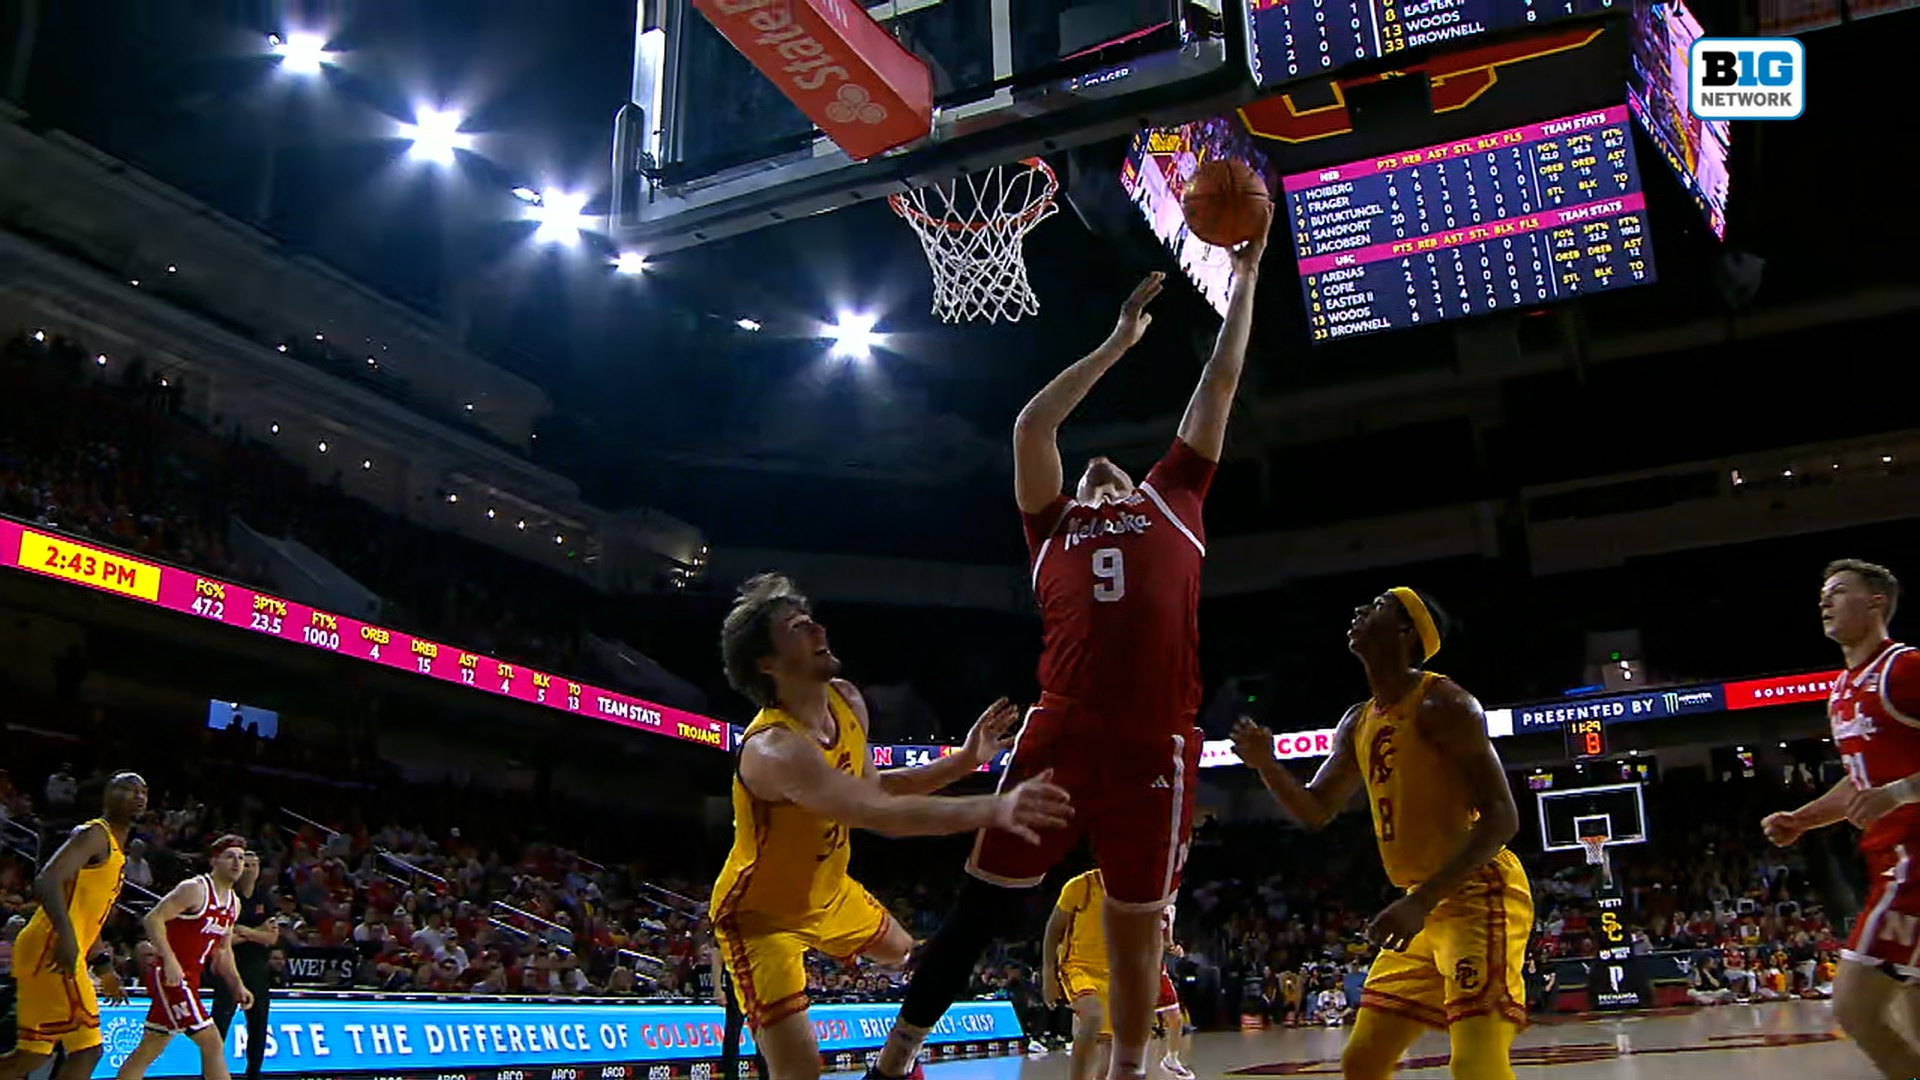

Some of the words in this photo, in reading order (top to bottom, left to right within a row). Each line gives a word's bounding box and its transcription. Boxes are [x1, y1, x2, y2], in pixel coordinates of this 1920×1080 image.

[1383, 25, 1402, 38] 13
[1406, 11, 1460, 31] WOODS
[1386, 9, 1395, 21] 8
[1386, 38, 1404, 52] 33
[1409, 22, 1484, 46] BROWNELL
[1527, 11, 1536, 22] 8
[1541, 121, 1572, 135] TEAM
[1574, 114, 1605, 129] STATS
[1377, 159, 1397, 169] PTS
[1402, 154, 1421, 164] REB
[1428, 148, 1447, 159] AST
[1454, 144, 1472, 153] STL
[1478, 137, 1498, 148] BLK
[1294, 194, 1299, 202] 1
[1306, 183, 1353, 199] HOIBERG
[1386, 174, 1392, 184] 7
[1412, 169, 1419, 178] 4
[1437, 164, 1444, 173] 2
[1464, 159, 1469, 167] 1
[1488, 153, 1495, 163] 0
[1296, 206, 1302, 215] 5
[1308, 197, 1350, 212] FRAGER
[1389, 187, 1396, 196] 8
[1414, 182, 1421, 191] 6
[1440, 177, 1446, 185] 1
[1466, 171, 1472, 180] 1
[1490, 166, 1497, 176] 0
[1298, 219, 1305, 229] 9
[1392, 201, 1399, 210] 6
[1417, 195, 1424, 205] 5
[1442, 191, 1449, 200] 3
[1468, 185, 1475, 195] 3
[1494, 181, 1499, 189] 1
[1391, 213, 1404, 225] 20
[1419, 209, 1426, 219] 3
[1445, 204, 1452, 213] 0
[1470, 199, 1478, 209] 2
[1496, 194, 1502, 203] 0
[1558, 208, 1588, 221] TEAM
[1590, 201, 1622, 215] STATS
[1316, 234, 1370, 253] JACOBSEN
[1397, 228, 1404, 237] 0
[1422, 223, 1428, 232] 0
[1447, 218, 1454, 227] 0
[1473, 213, 1480, 222] 0
[1498, 207, 1505, 217] 0
[1393, 243, 1412, 252] PTS
[1418, 238, 1437, 249] REB
[1444, 233, 1463, 243] AST
[1470, 229, 1488, 238] STL
[1494, 224, 1514, 234] BLK
[1309, 277, 1315, 285] 0
[1322, 267, 1364, 283] ARENAS
[1402, 259, 1410, 267] 4
[1428, 253, 1434, 263] 0
[1453, 249, 1460, 258] 2
[1479, 244, 1485, 252] 1
[1504, 239, 1511, 249] 0
[1311, 290, 1318, 298] 6
[1324, 282, 1355, 296] COFIE
[1404, 272, 1412, 281] 2
[1431, 267, 1436, 275] 1
[1456, 262, 1462, 271] 0
[1481, 257, 1488, 267] 0
[1506, 252, 1513, 261] 0
[1312, 316, 1325, 325] 13
[1328, 307, 1370, 323] WOODS
[1409, 299, 1416, 308] 9
[1434, 293, 1441, 303] 3
[1460, 289, 1468, 298] 4
[1486, 284, 1493, 294] 2
[1511, 279, 1518, 289] 0
[1314, 303, 1320, 311] 8
[1326, 293, 1366, 309] EASTER
[1408, 285, 1414, 294] 6
[1432, 280, 1439, 289] 3
[1457, 275, 1464, 285] 2
[1484, 271, 1490, 280] 0
[1508, 266, 1515, 275] 0
[1315, 329, 1328, 339] 33
[1331, 318, 1390, 336] BROWNELL
[1412, 312, 1419, 321] 8
[1438, 308, 1443, 316] 1
[1462, 303, 1470, 313] 0
[1488, 298, 1496, 308] 0
[1514, 293, 1520, 303] 3
[44, 546, 97, 577] 2:43
[103, 561, 136, 588] PM
[1092, 548, 1125, 602] 9
[192, 597, 223, 619] 47.2
[251, 612, 282, 633] 23.5
[304, 627, 338, 649] 100.0
[370, 645, 379, 659] 4
[418, 657, 430, 673] 15
[462, 669, 474, 684] 12
[501, 679, 509, 693] 4
[538, 689, 544, 702] 5
[568, 696, 579, 709] 13
[196, 579, 225, 599] FG%
[254, 595, 286, 615] 3PT%
[312, 612, 336, 630] FT%
[361, 627, 389, 643] OREB
[412, 640, 437, 657] DREB
[459, 653, 478, 667] AST
[498, 664, 514, 678] STL
[534, 673, 550, 687] BLK
[568, 683, 580, 695] TO
[598, 697, 628, 717] TEAM
[630, 706, 660, 726] STATS
[1522, 702, 1624, 726] PRESENTED
[1632, 699, 1653, 714] BY
[678, 723, 720, 744] TROJANS
[1277, 733, 1336, 754] COR
[873, 747, 892, 766] N
[905, 750, 930, 767] 54
[1598, 898, 1622, 908] YETI
[963, 1013, 995, 1034] CRISP
[234, 1023, 330, 1058] ASTE
[344, 1024, 413, 1054] THE
[424, 1024, 591, 1053] DIFFERENCE
[600, 1023, 628, 1050] OF
[641, 1023, 725, 1049] GOLDEN
[601, 1067, 625, 1078] ARCO
